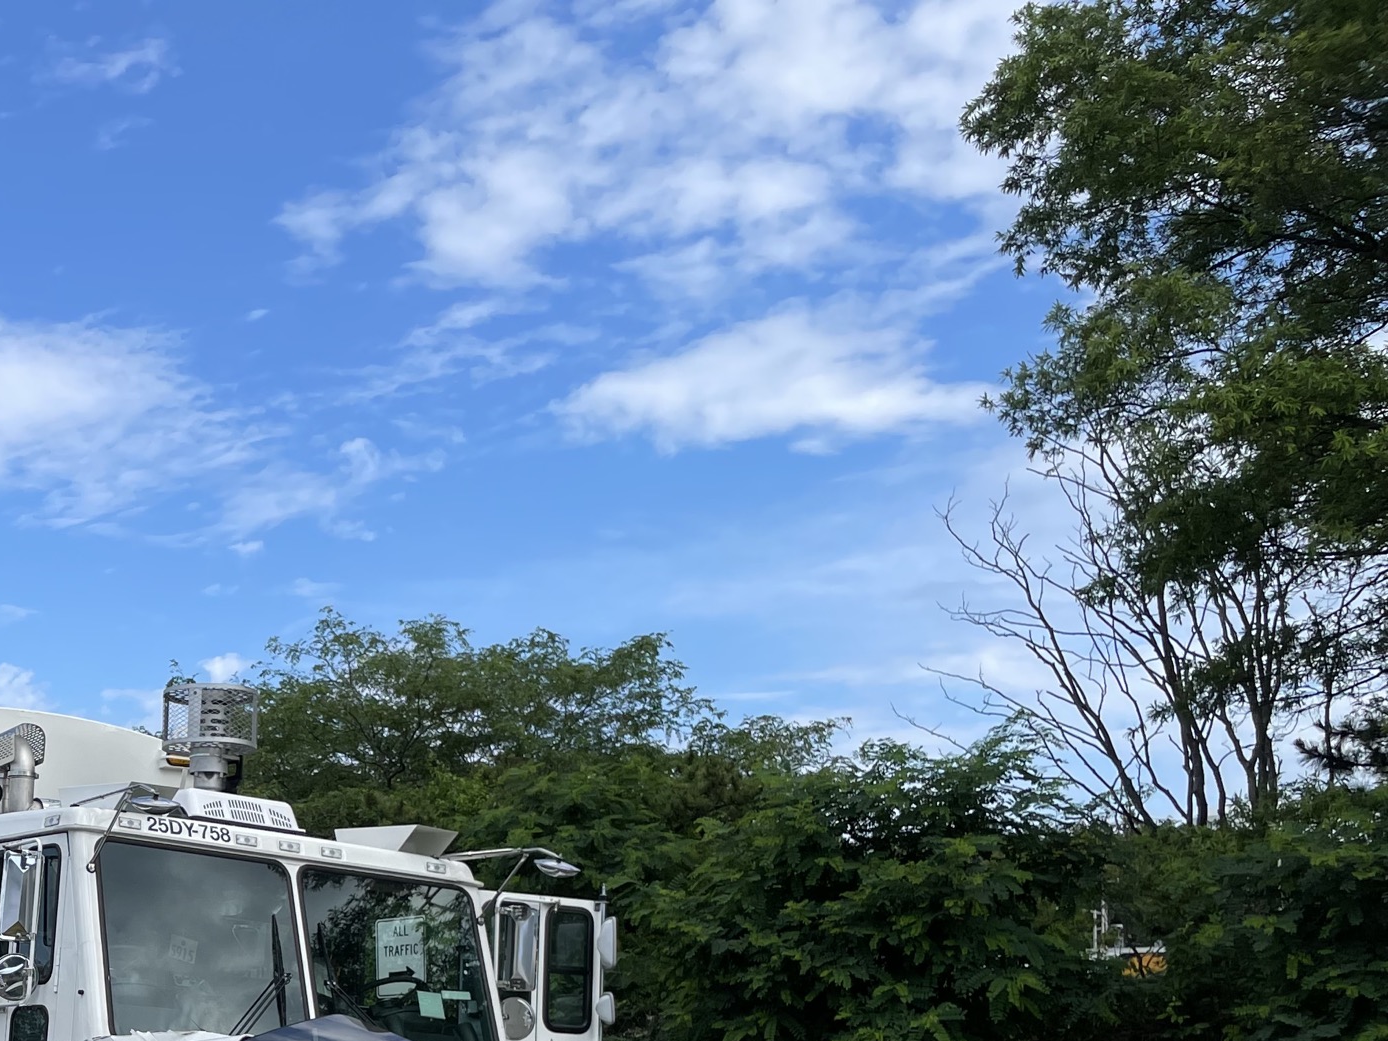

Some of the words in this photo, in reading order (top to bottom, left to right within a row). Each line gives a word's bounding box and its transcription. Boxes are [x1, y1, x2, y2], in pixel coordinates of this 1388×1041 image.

[147, 816, 231, 843] 25DY-758
[393, 925, 409, 937] ALL
[384, 943, 419, 957] TRAFFIC
